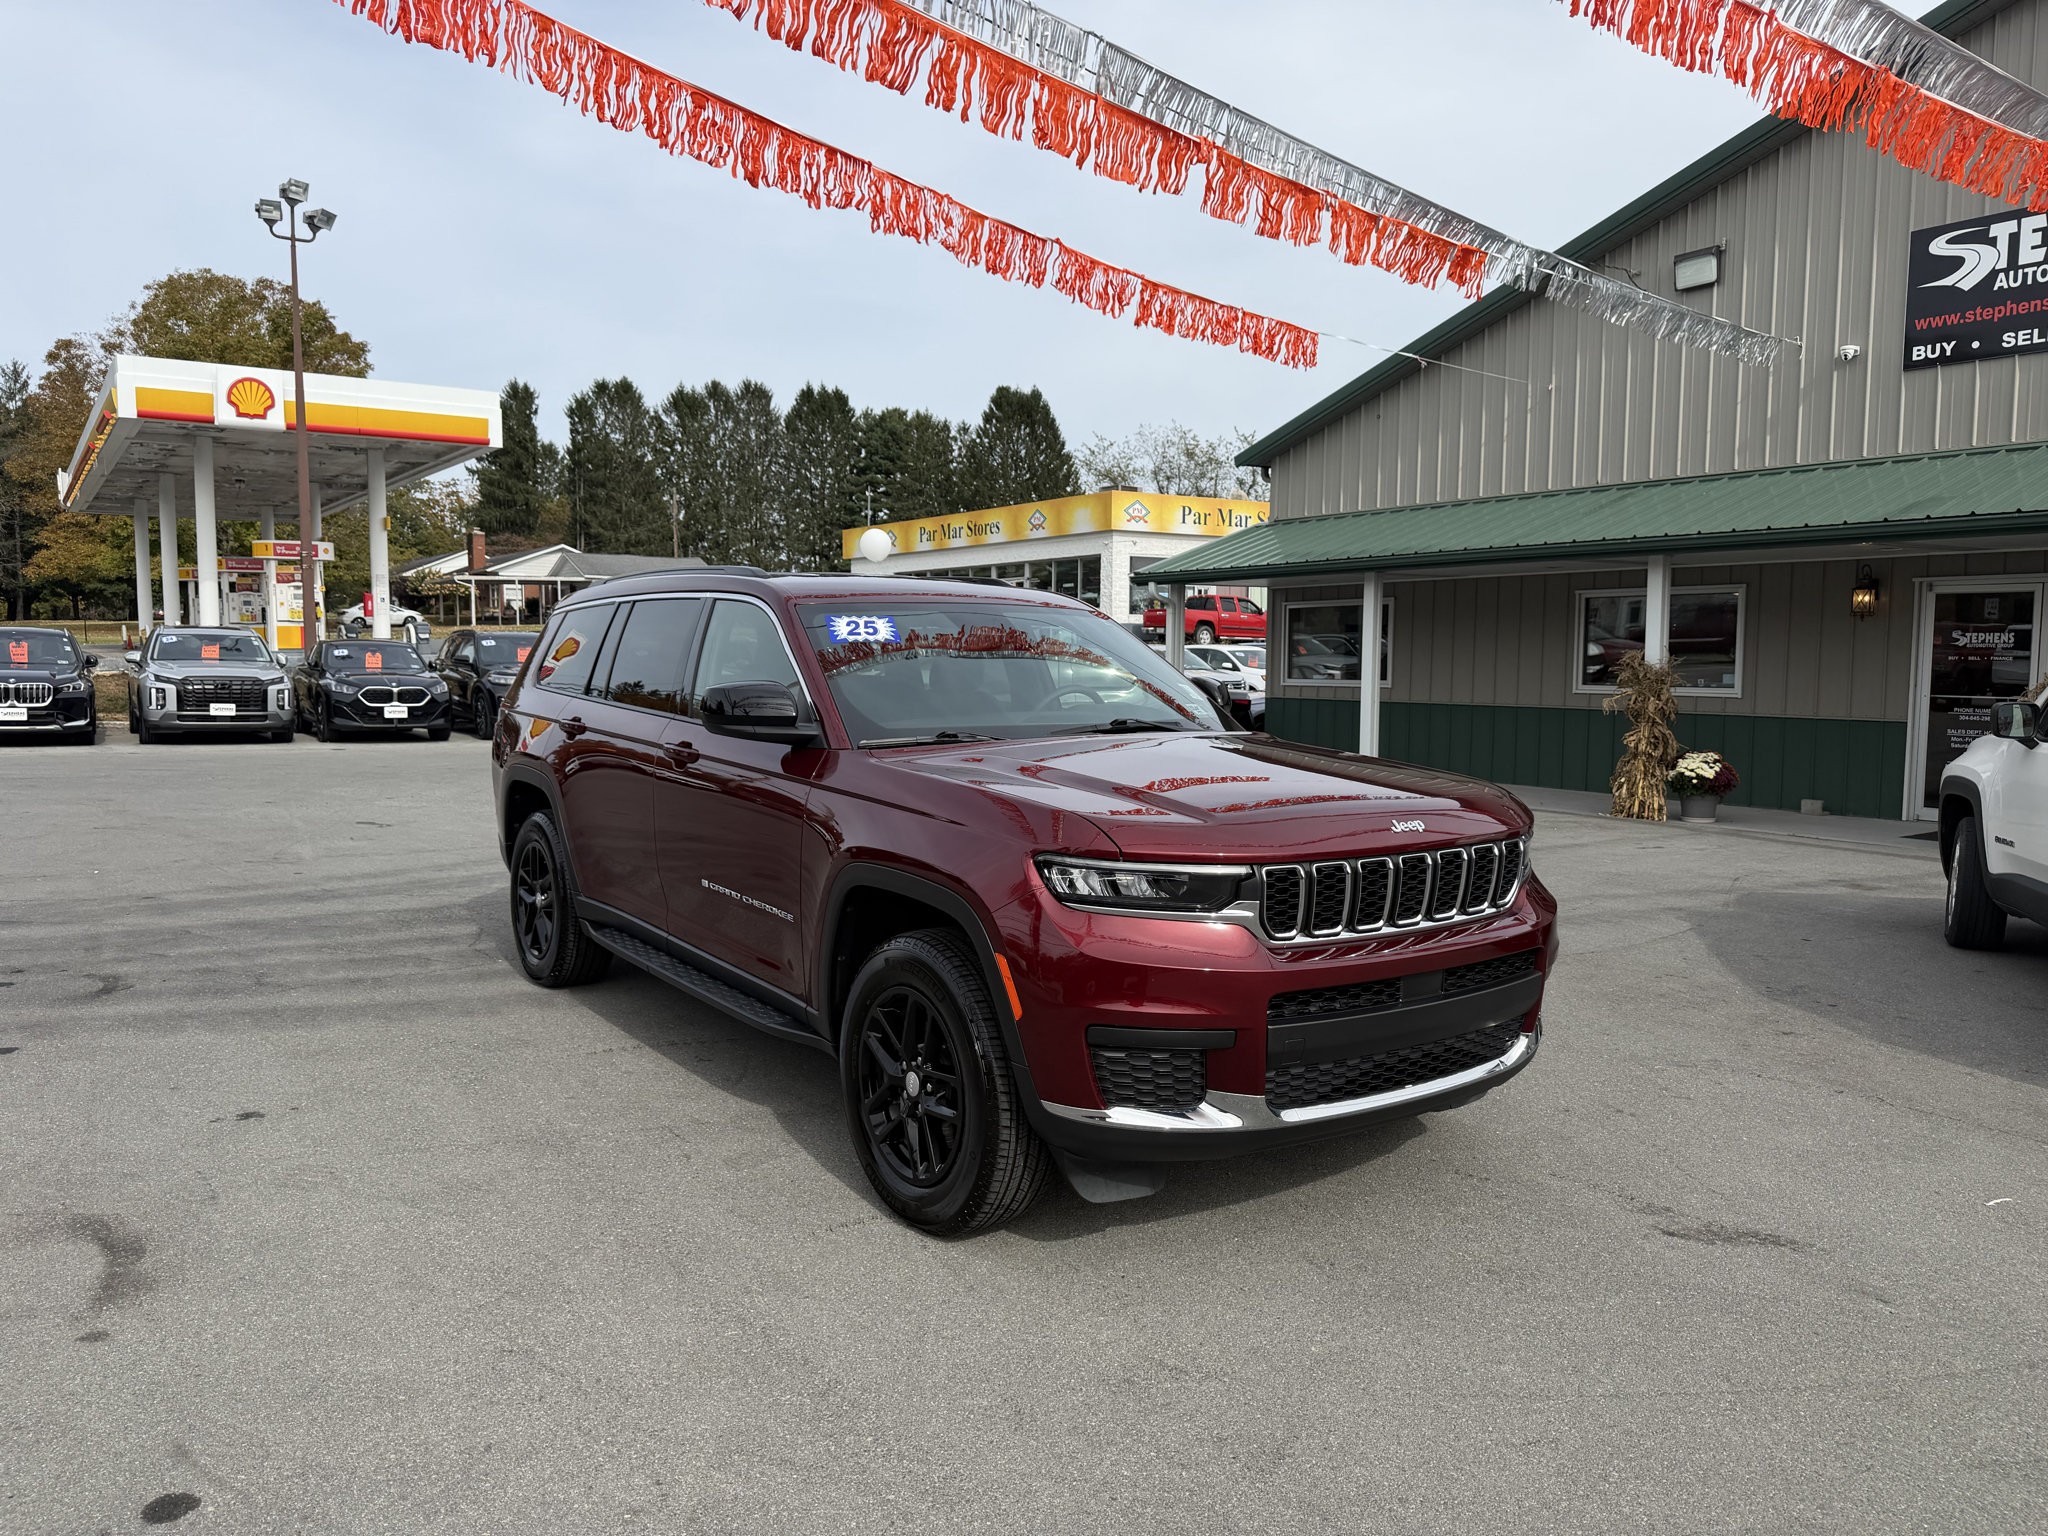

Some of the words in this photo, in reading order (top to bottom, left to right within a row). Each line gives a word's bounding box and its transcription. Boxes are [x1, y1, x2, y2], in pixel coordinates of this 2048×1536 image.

[1917, 214, 2048, 291] STE
[1993, 265, 2048, 291] AUTO
[1915, 298, 2048, 330] www.stephens
[1912, 341, 1956, 361] BUY
[2001, 328, 2048, 348] SEL
[1181, 505, 1211, 526] Par
[1217, 508, 1252, 528] Mar
[919, 526, 938, 543] Par
[941, 522, 964, 541] Mar
[966, 519, 1001, 538] Stores
[845, 620, 878, 636] 25
[1950, 629, 2015, 647] STEPHENS
[1391, 820, 1425, 833] Jeep
[710, 882, 741, 900] GRAND
[742, 895, 794, 921] CHEROKEE
